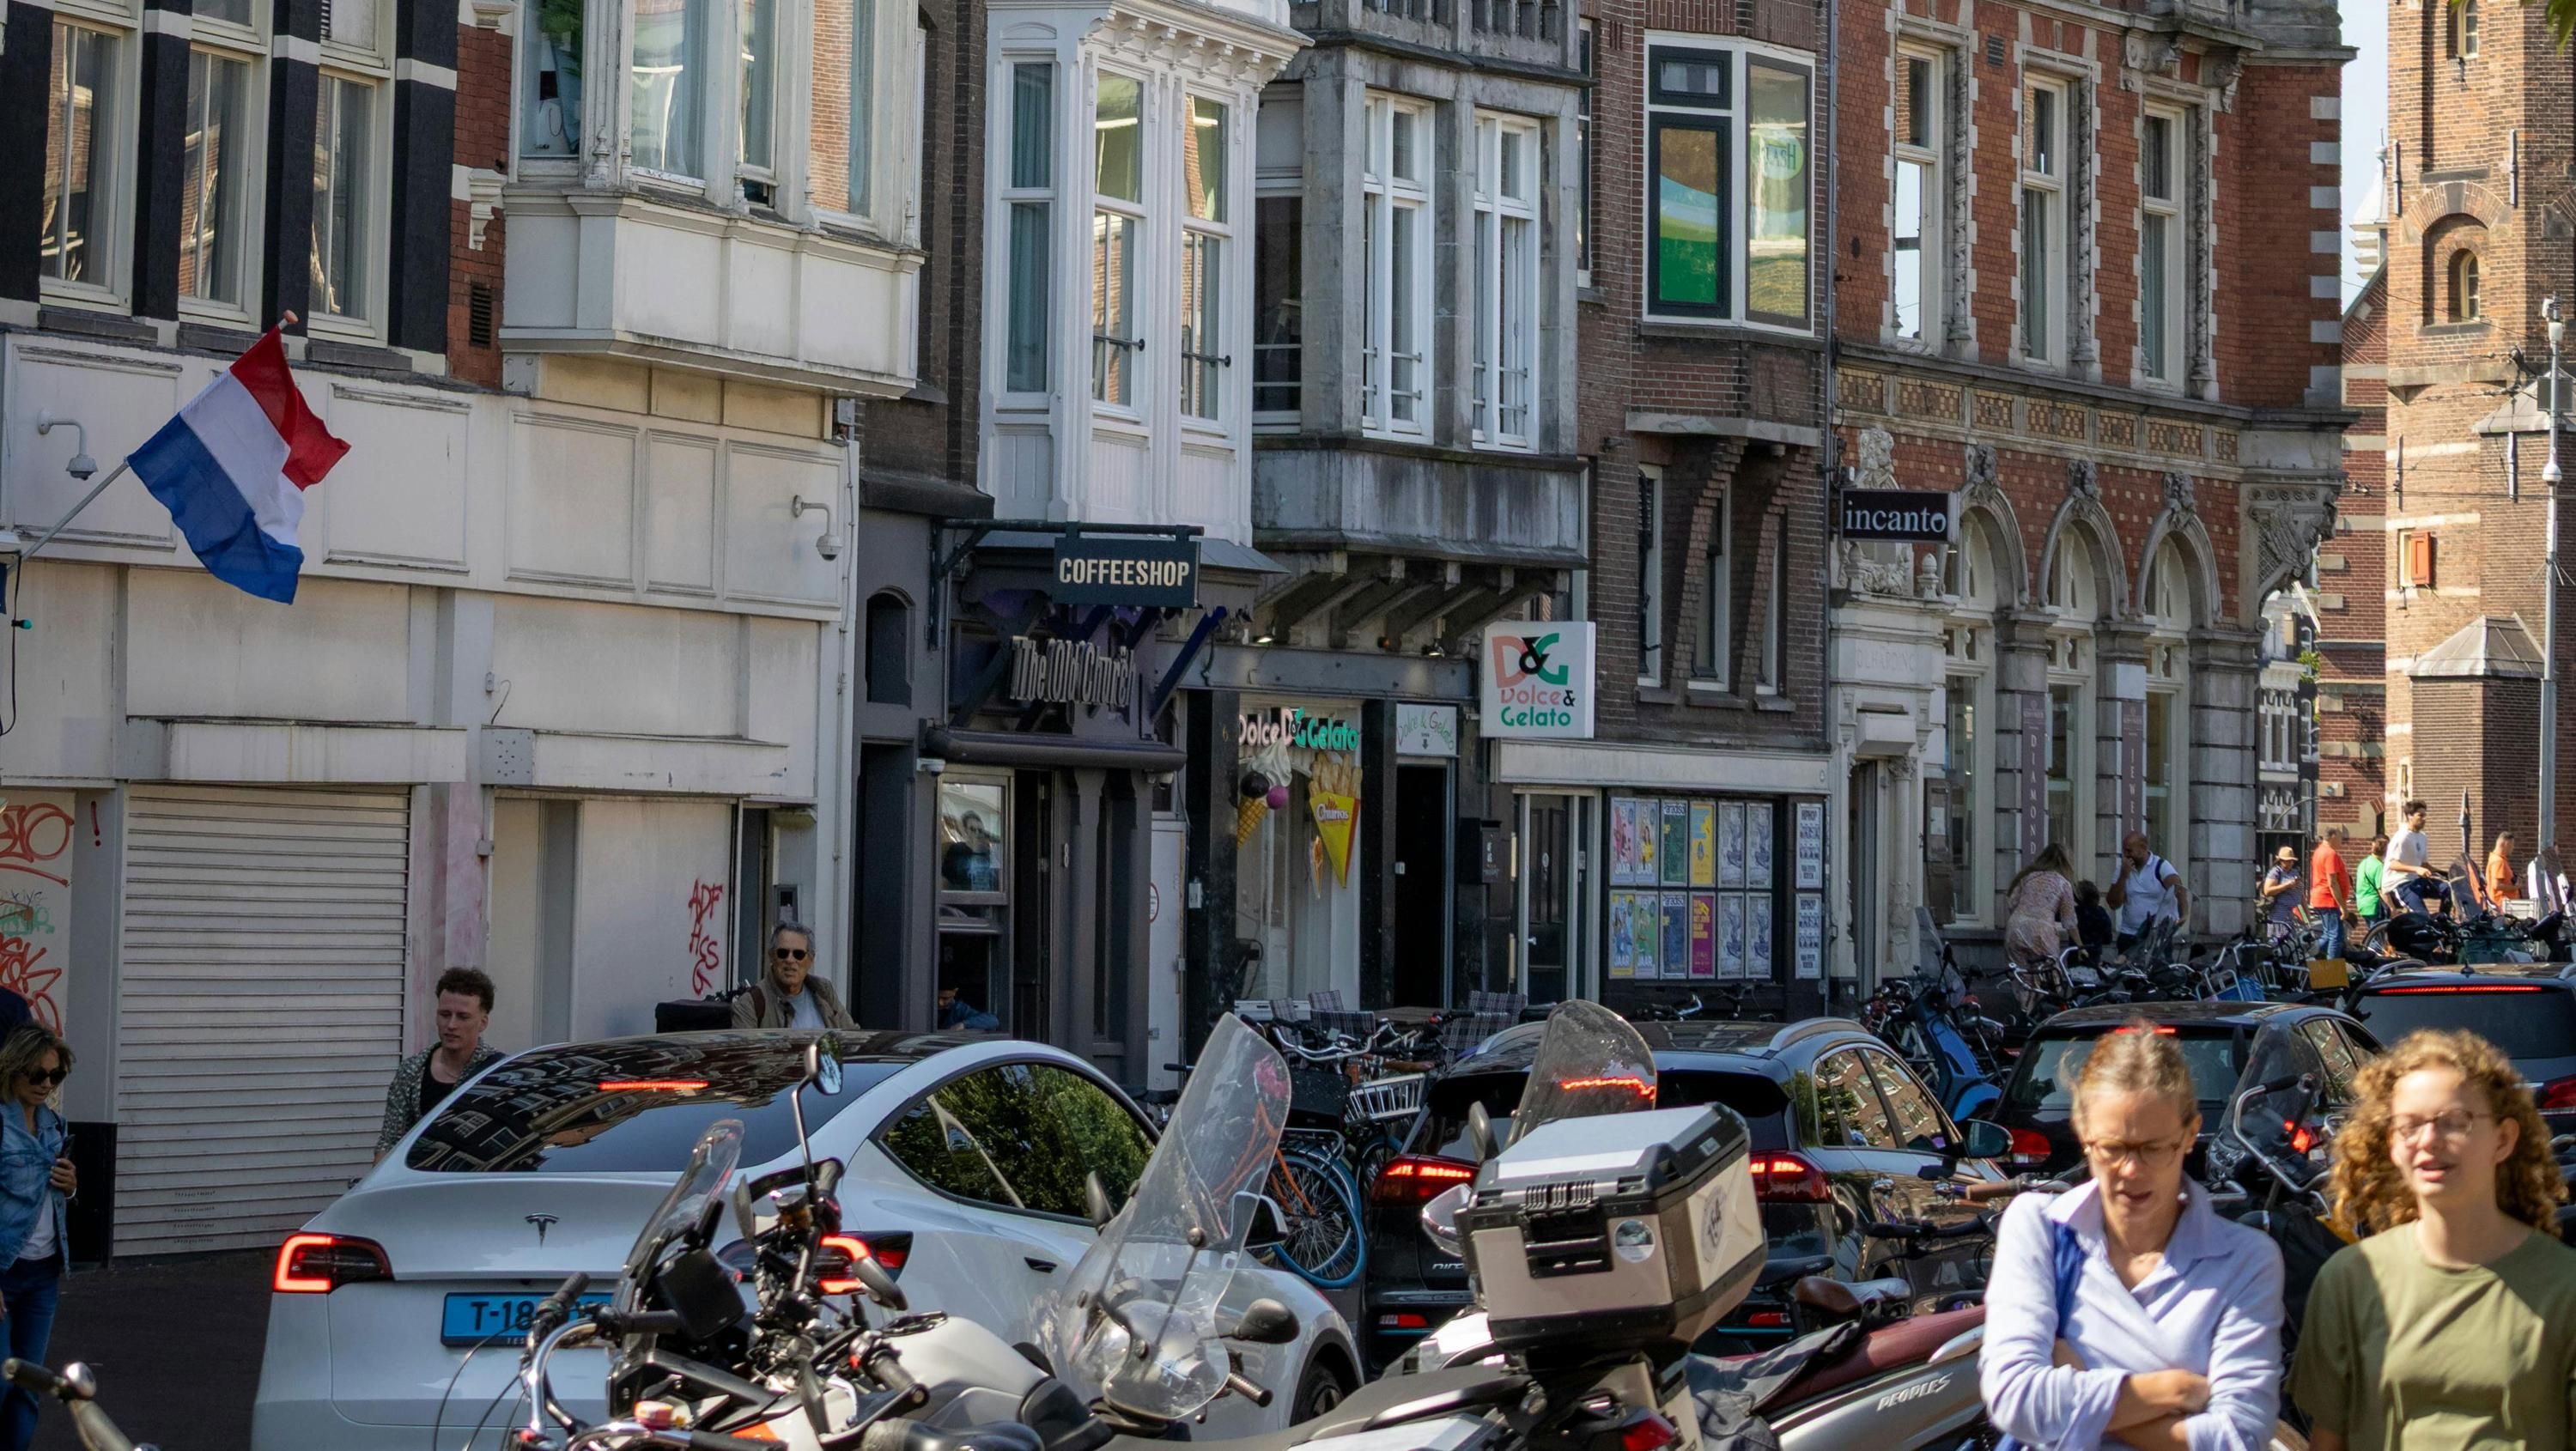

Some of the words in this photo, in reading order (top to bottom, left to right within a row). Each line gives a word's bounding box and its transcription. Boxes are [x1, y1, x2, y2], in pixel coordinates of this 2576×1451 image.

[1846, 500, 1947, 533] incanto
[1059, 557, 1190, 587] COFFEESHOP
[1012, 635, 1048, 701] The
[1492, 632, 1570, 689] D&G
[1500, 684, 1561, 706] Dolce
[1563, 689, 1577, 707] &
[1500, 706, 1571, 727] Gelato
[1307, 716, 1359, 751] Gelato
[1063, 842, 1070, 869] 8
